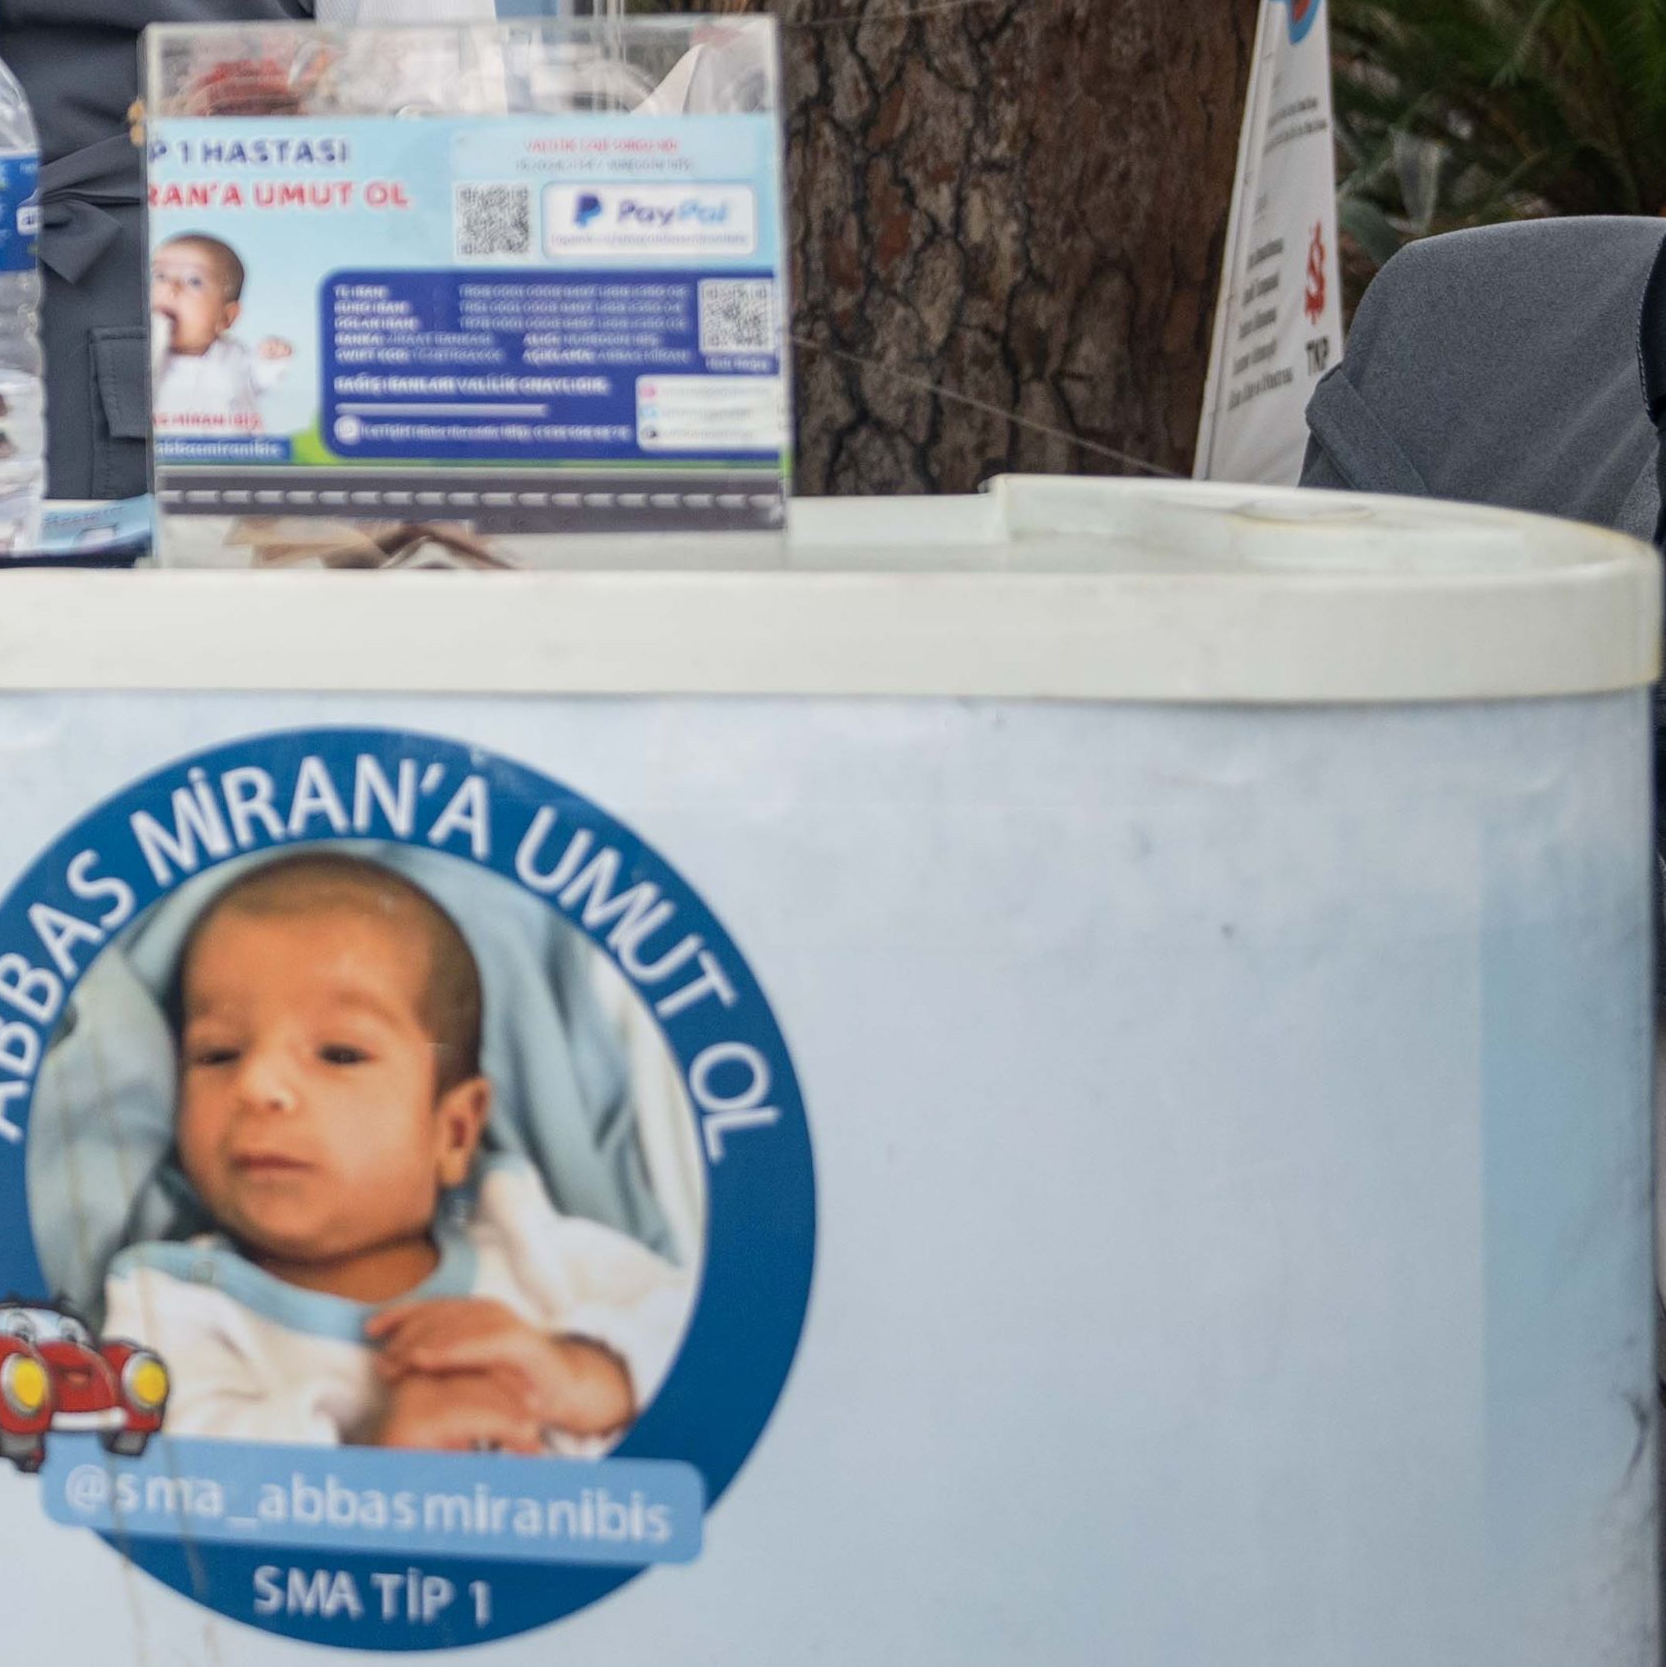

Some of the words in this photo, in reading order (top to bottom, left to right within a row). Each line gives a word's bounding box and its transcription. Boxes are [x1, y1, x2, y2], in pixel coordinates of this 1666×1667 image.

[201, 138, 349, 164] HASTASI
[254, 182, 354, 209] UMUT
[364, 182, 411, 209] OL
[618, 198, 728, 227] PayPal
[129, 753, 492, 887] MİRAN'A
[514, 805, 738, 1019] UMUT
[688, 1041, 782, 1165] OL
[66, 1462, 674, 1542] @sma_abbasmiranibis
[253, 1564, 363, 1621] SMA
[371, 1566, 457, 1624] TİP
[468, 1579, 493, 1627] 1
